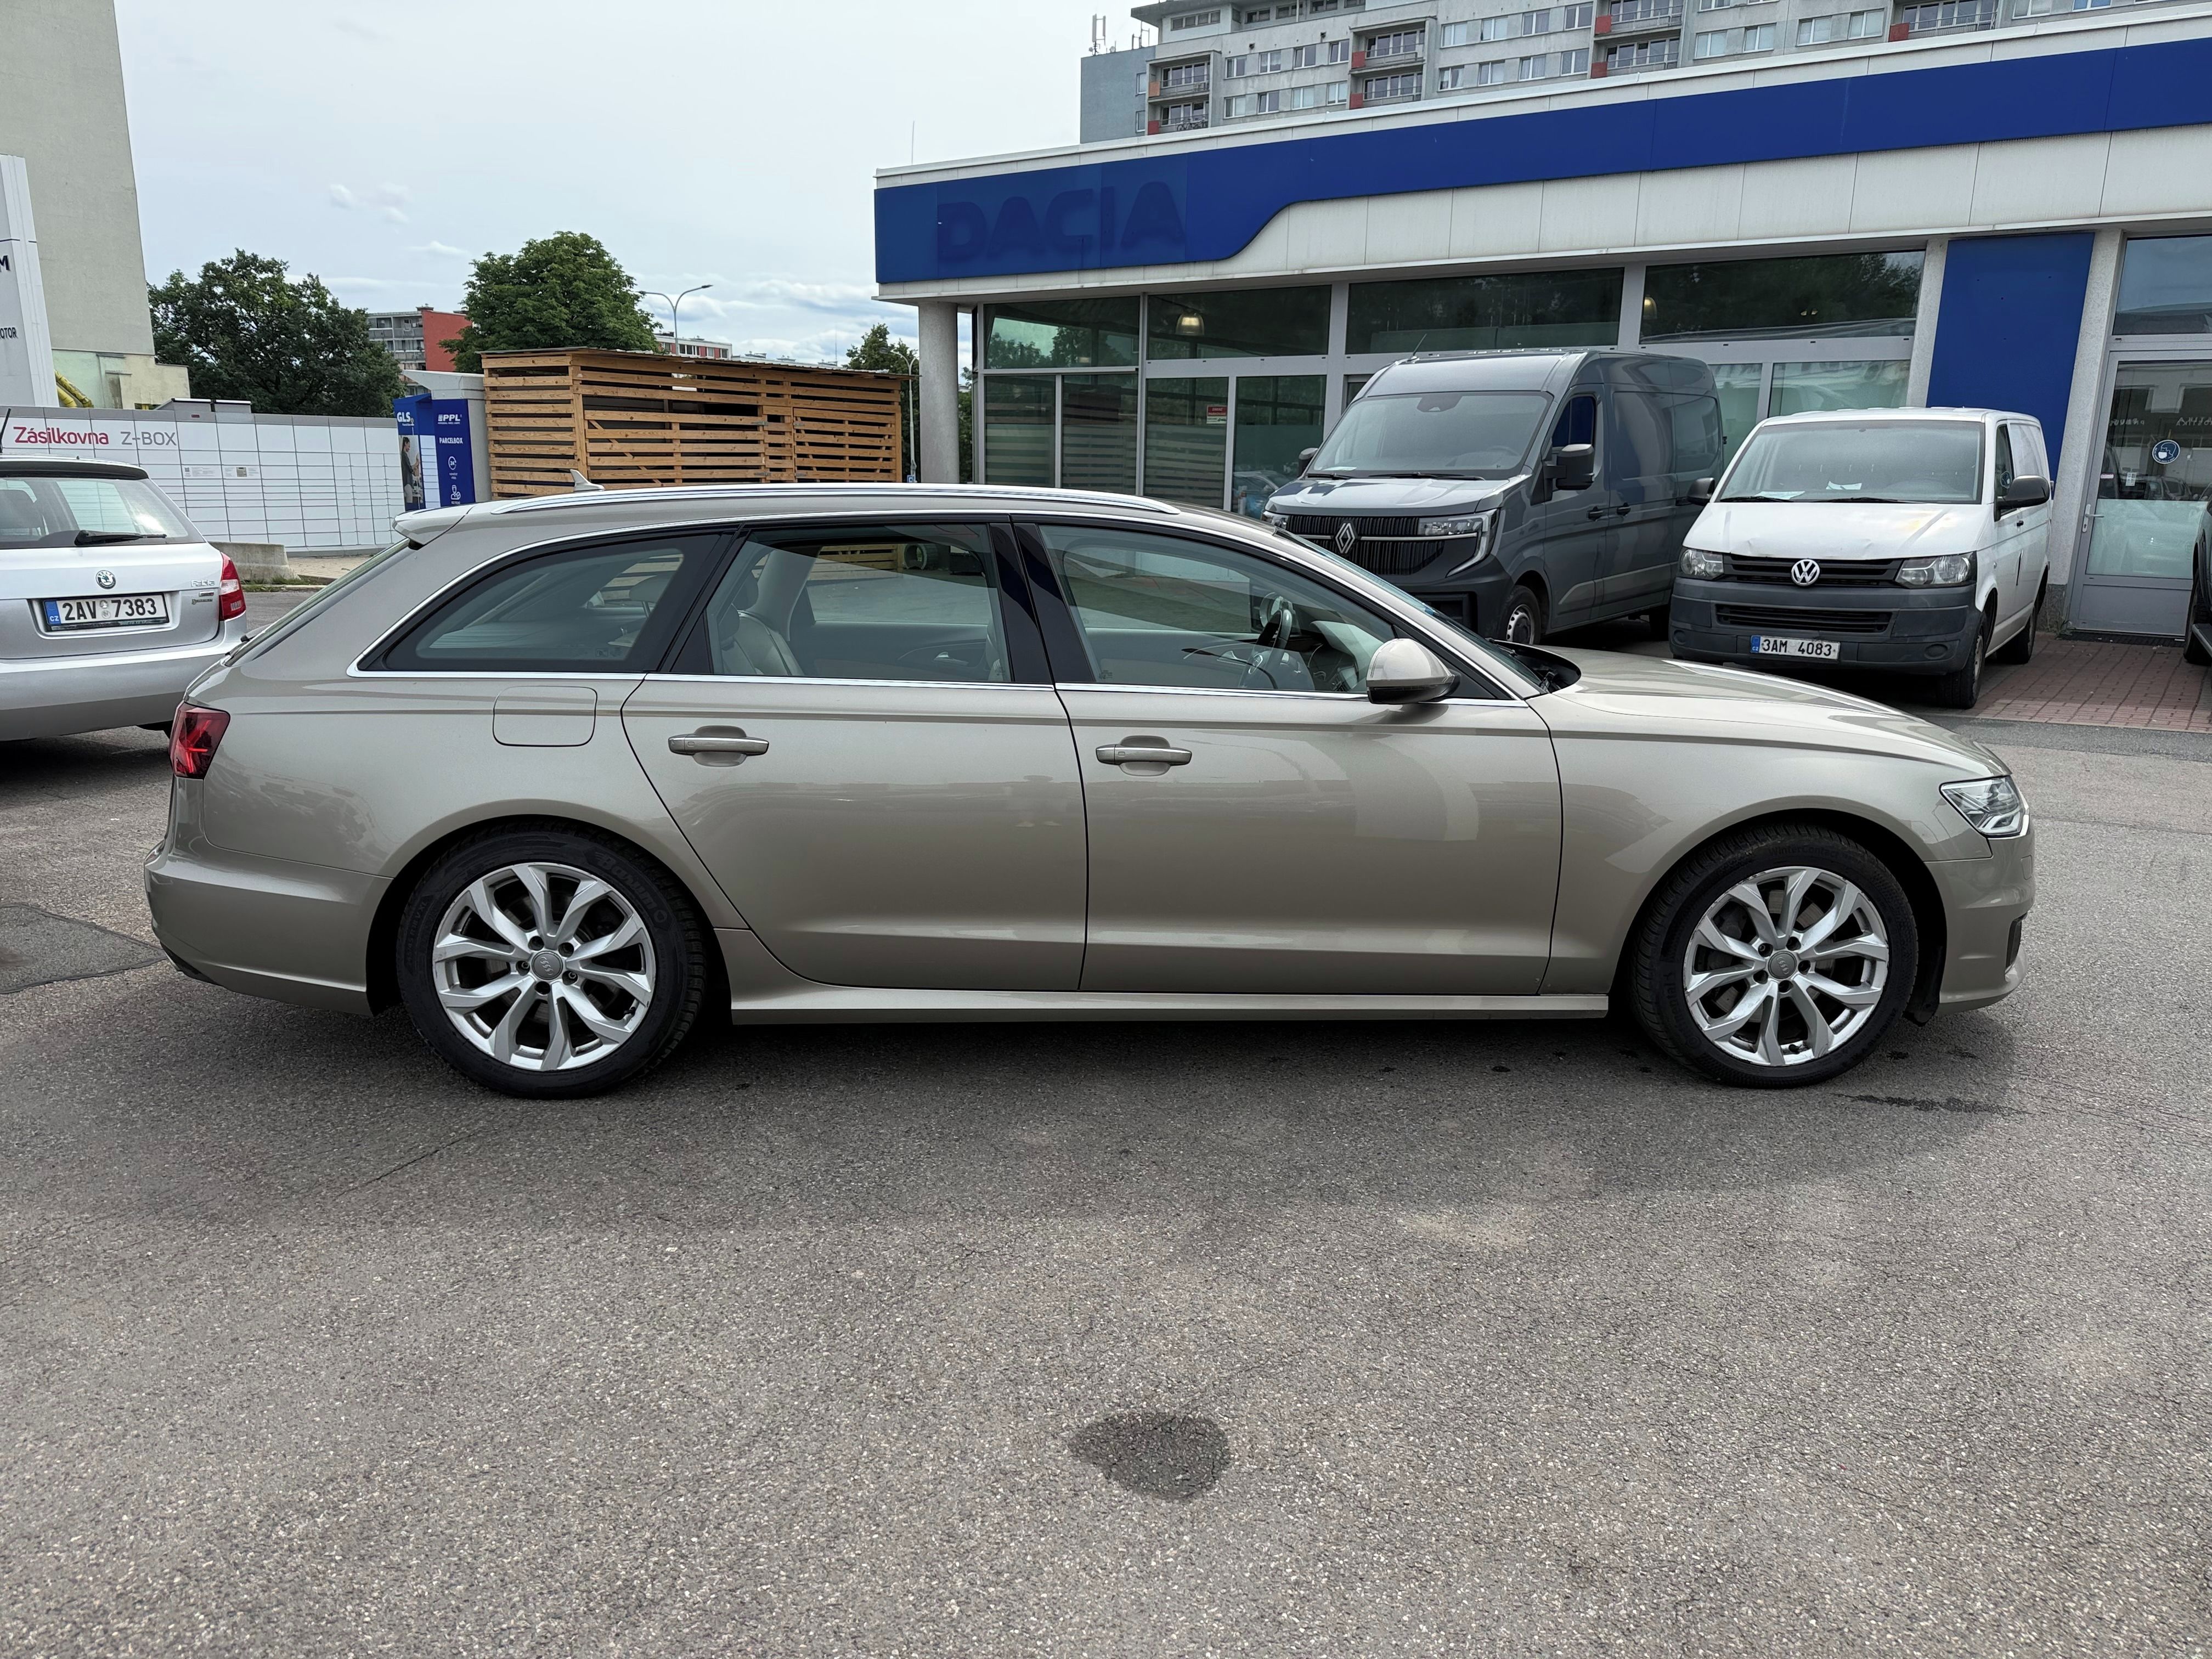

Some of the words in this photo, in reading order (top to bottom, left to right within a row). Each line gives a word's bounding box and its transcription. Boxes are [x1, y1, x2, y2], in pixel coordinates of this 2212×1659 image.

[936, 182, 1187, 258] DACIA
[0, 327, 17, 339] OTOR
[397, 412, 410, 422] GLS
[13, 426, 109, 445] Zásilkovna
[120, 431, 177, 445] Z-BOX
[62, 601, 97, 621] 2AV
[111, 597, 157, 617] 7383
[1762, 639, 1788, 653] 3AM
[1798, 641, 1832, 656] 4083
